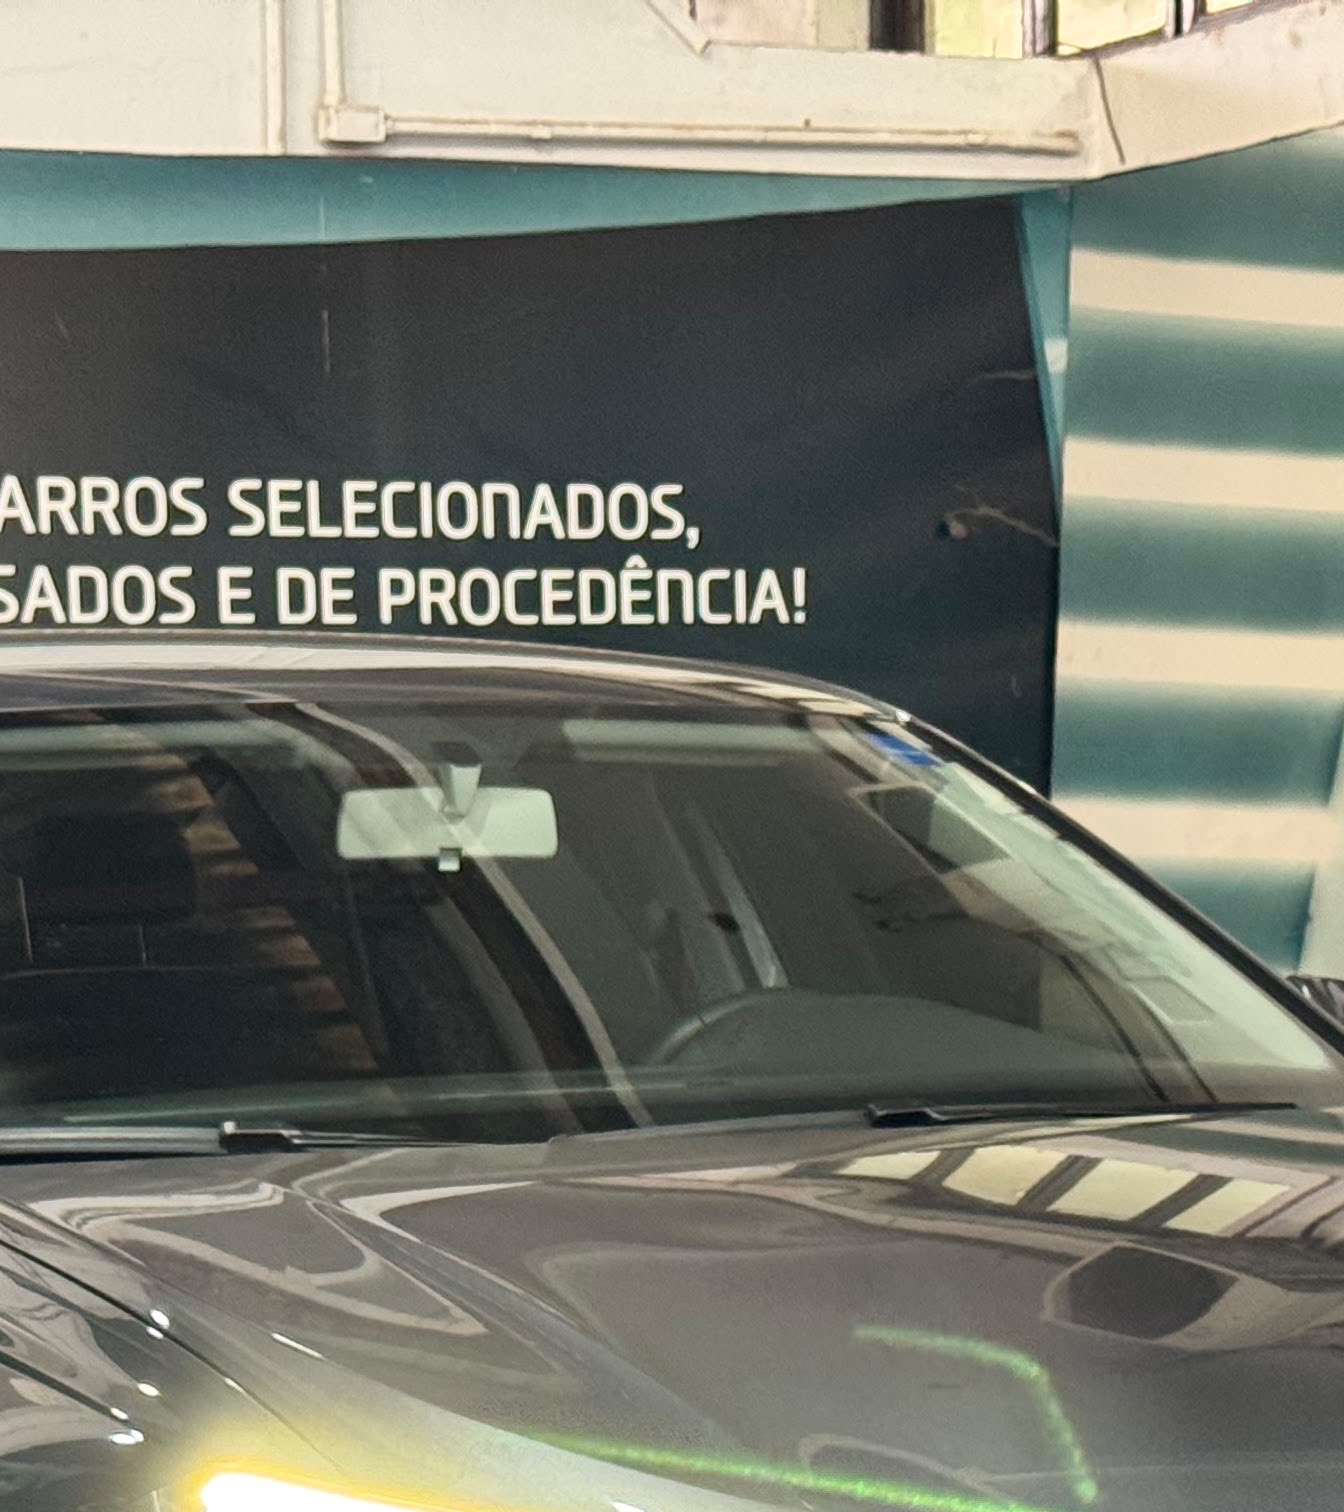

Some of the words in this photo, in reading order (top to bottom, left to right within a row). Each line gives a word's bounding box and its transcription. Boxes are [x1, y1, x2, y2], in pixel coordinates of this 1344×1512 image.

[228, 478, 700, 550] SELECIONADOS,
[217, 565, 256, 625] E
[276, 565, 359, 626] DE
[378, 554, 807, 626] PROCEDÊNCIA!
